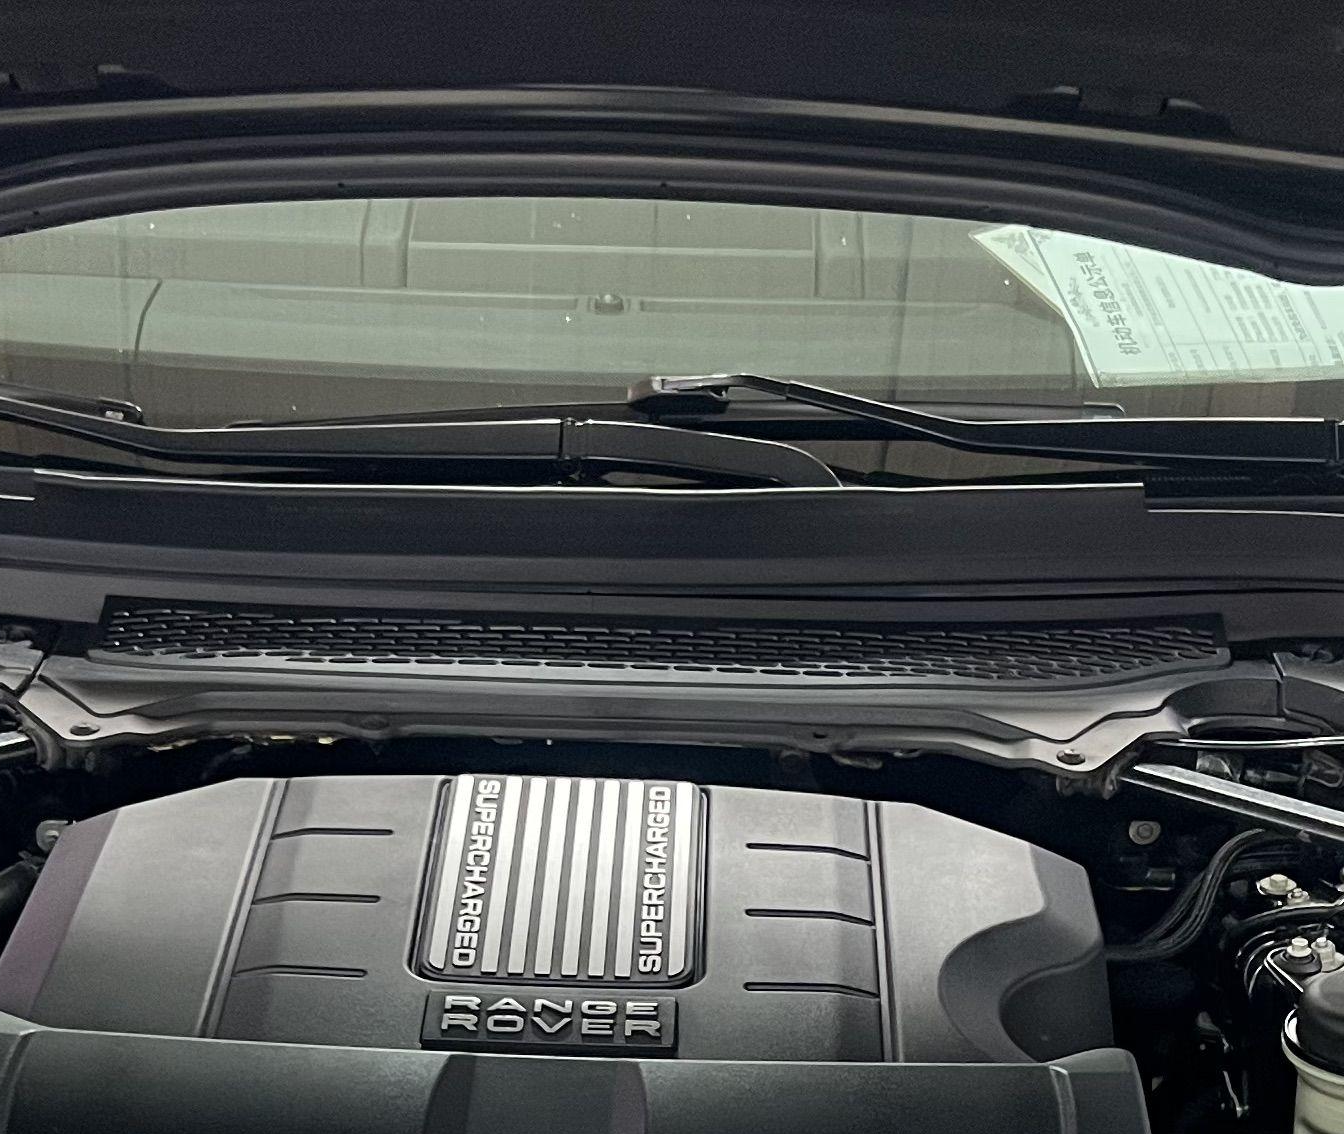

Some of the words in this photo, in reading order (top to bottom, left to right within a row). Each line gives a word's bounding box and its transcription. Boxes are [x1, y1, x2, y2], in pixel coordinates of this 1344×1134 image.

[452, 779, 501, 968] SUPERCHARGED
[638, 785, 671, 974] SUPERCHARGED
[441, 1013, 661, 1038] ROVER
[444, 995, 659, 1015] RANGE
